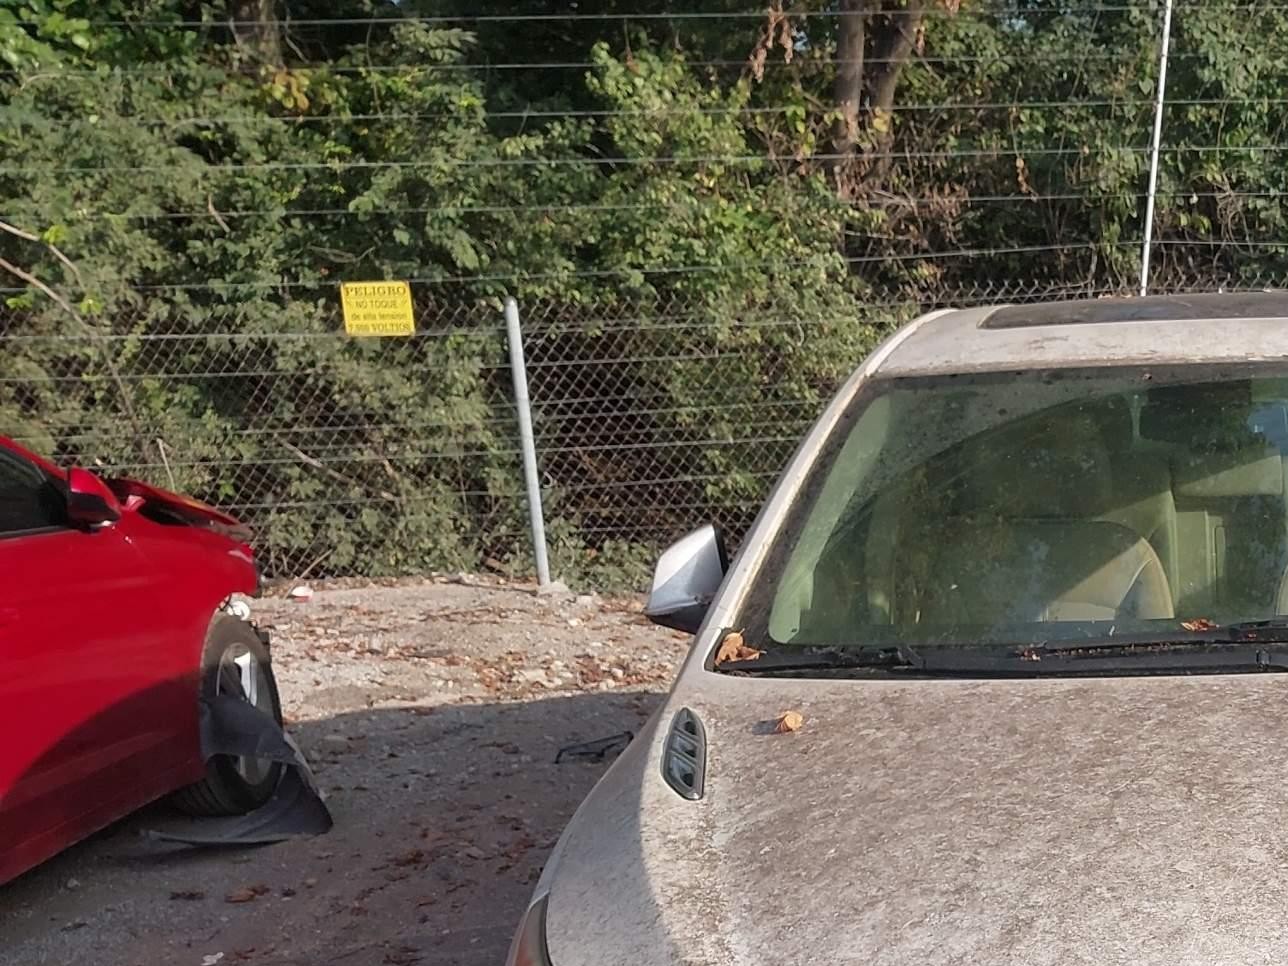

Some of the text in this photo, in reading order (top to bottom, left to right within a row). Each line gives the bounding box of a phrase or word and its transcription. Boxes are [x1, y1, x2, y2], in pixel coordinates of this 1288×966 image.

[345, 286, 406, 296] PELIGRO
[370, 300, 398, 309] TOQUE
[371, 322, 409, 332] VOLTIOS
